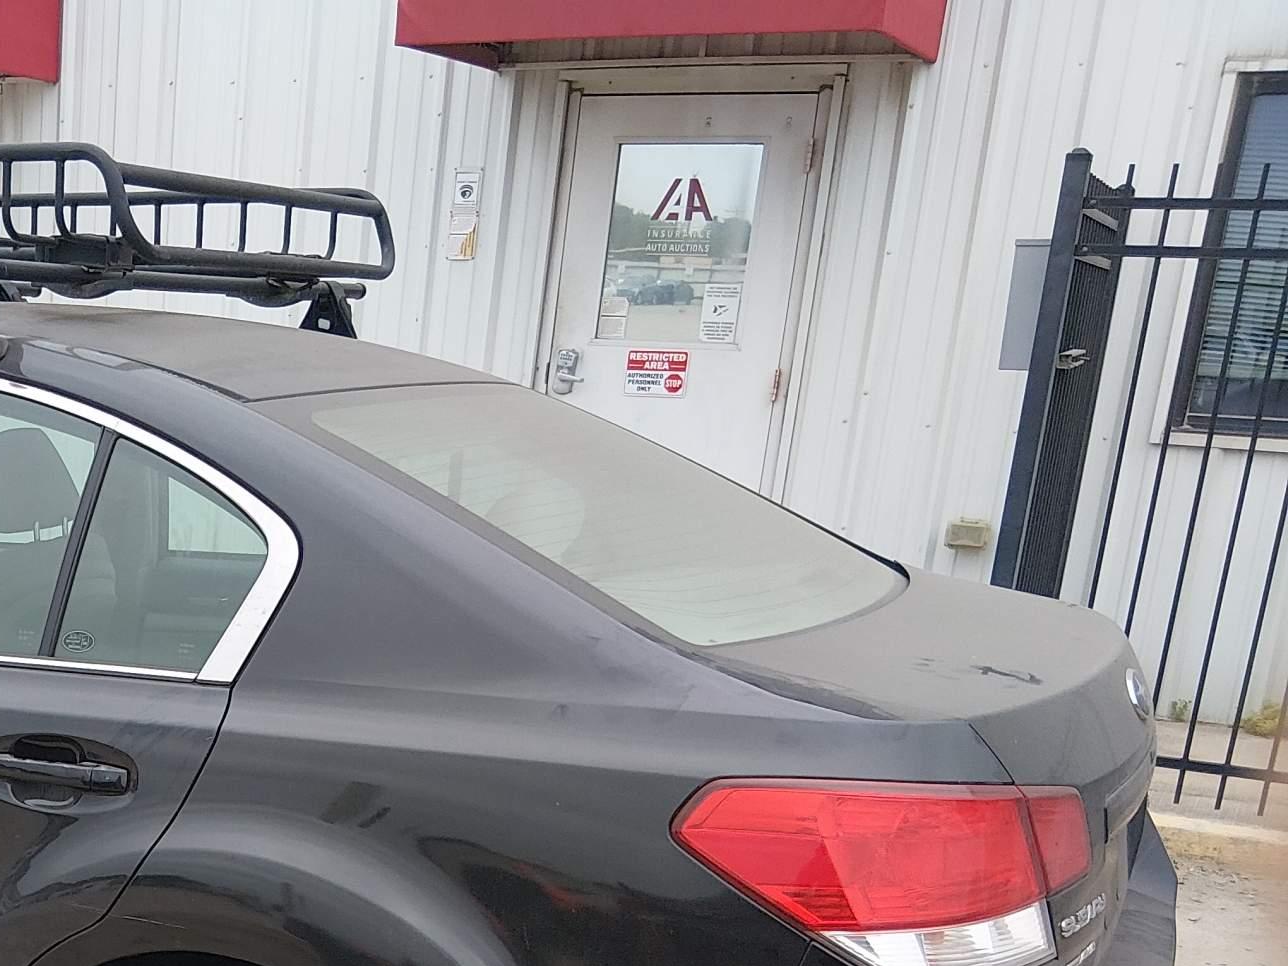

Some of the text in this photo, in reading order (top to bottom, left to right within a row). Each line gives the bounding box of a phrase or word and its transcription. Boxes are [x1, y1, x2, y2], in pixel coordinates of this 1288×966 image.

[647, 229, 711, 239] INSURANCE
[645, 243, 710, 253] AUTO AUCTIONS
[629, 352, 687, 361] RESTRICTED
[643, 361, 669, 370] AREA
[665, 379, 682, 388] STOP
